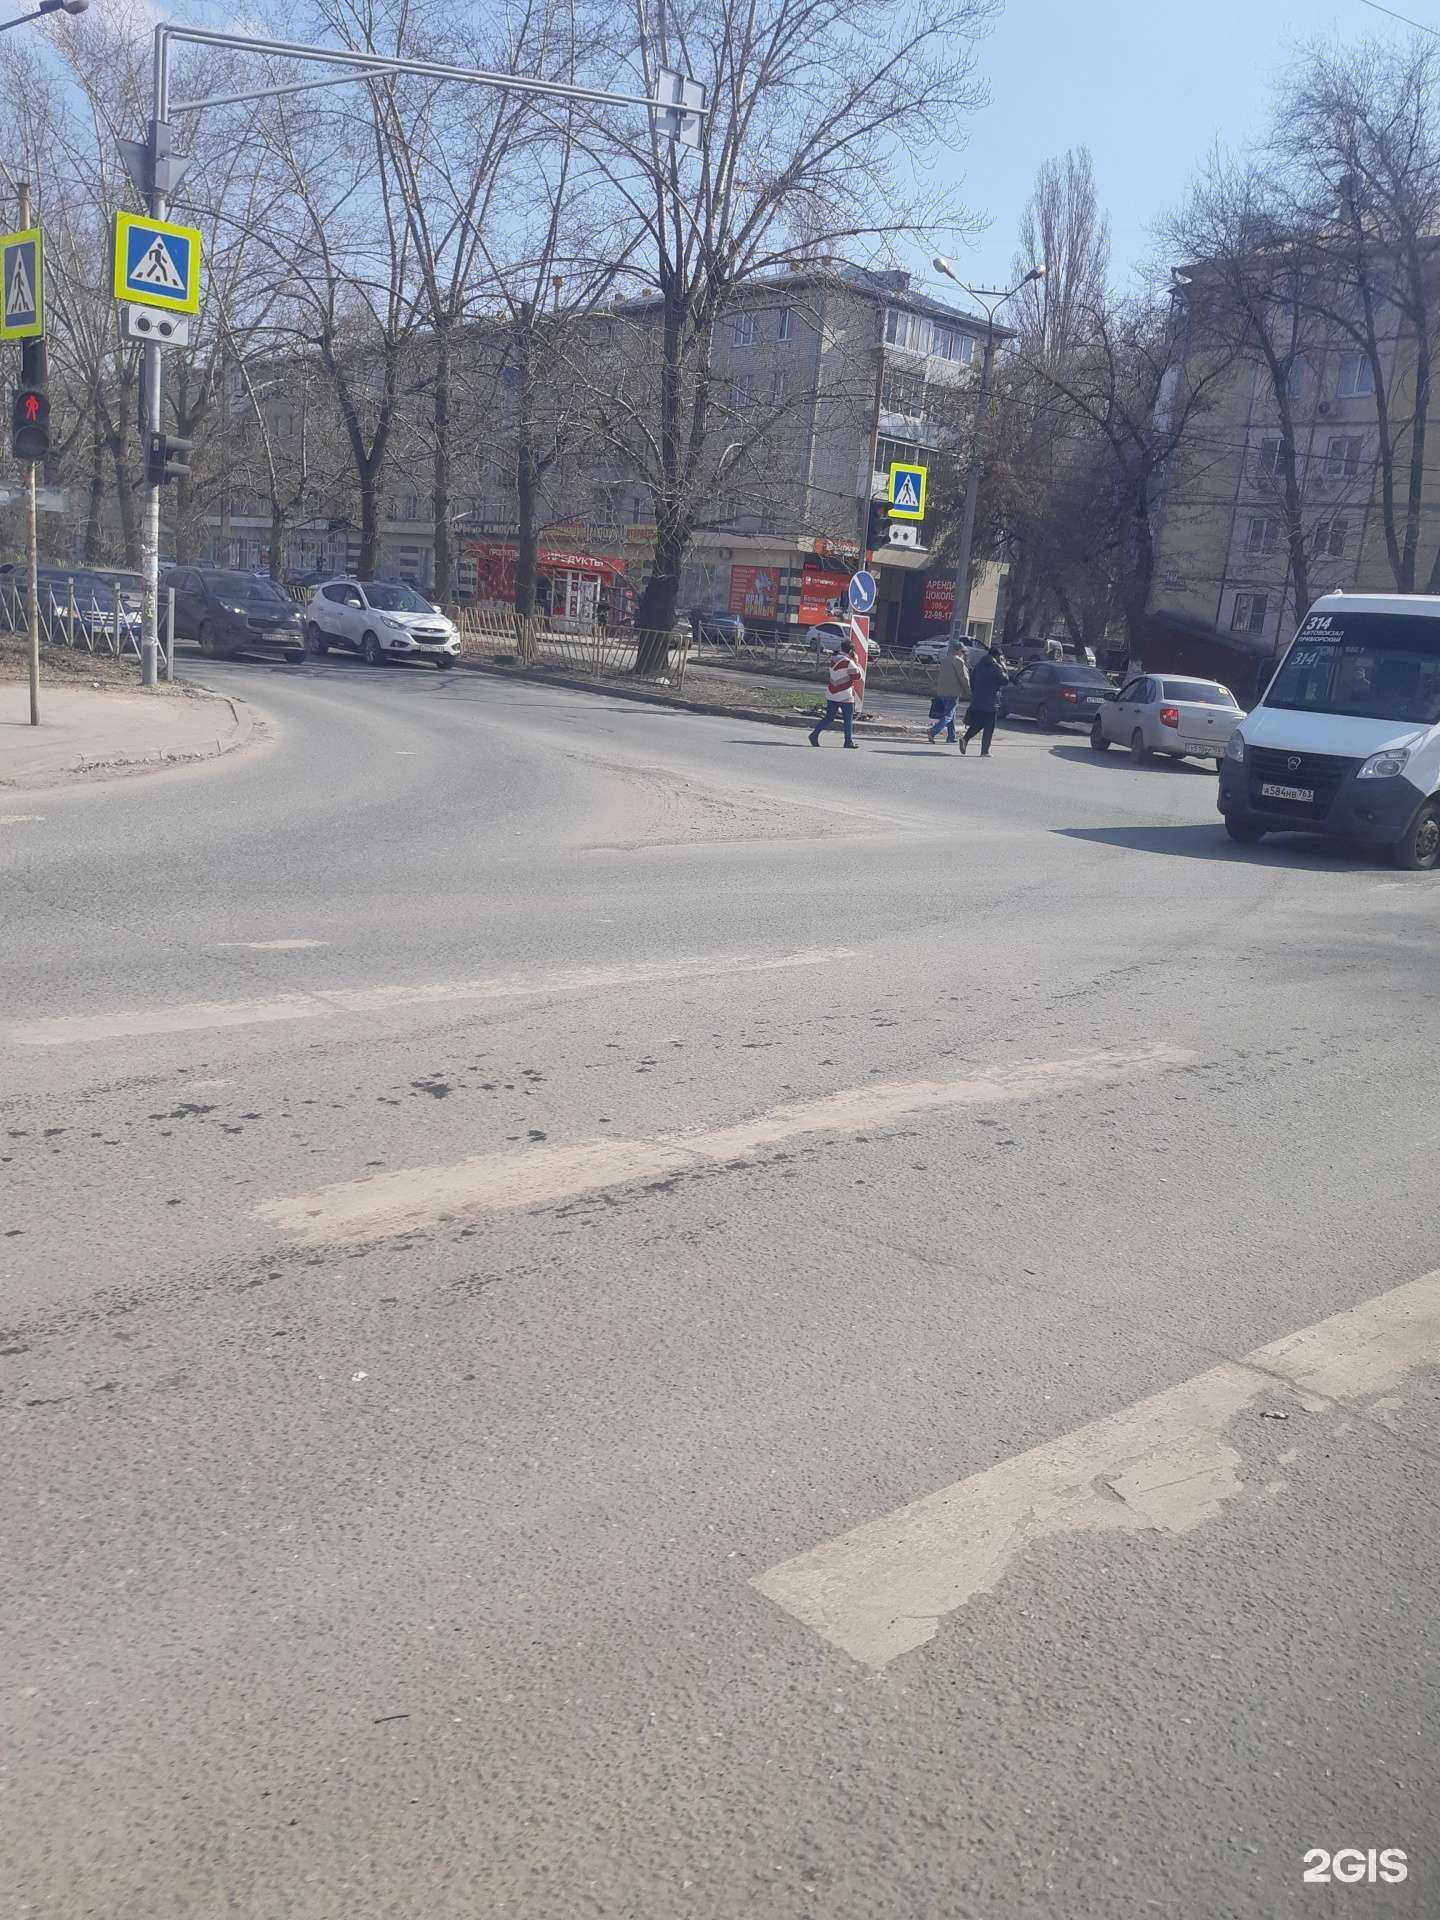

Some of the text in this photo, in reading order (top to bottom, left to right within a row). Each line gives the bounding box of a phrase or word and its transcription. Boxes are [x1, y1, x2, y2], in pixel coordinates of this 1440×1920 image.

[546, 551, 604, 567] ПРОДУКТЫ
[926, 580, 956, 591] АРЕНДА
[1307, 616, 1333, 629] 314
[1291, 653, 1316, 665] 314
